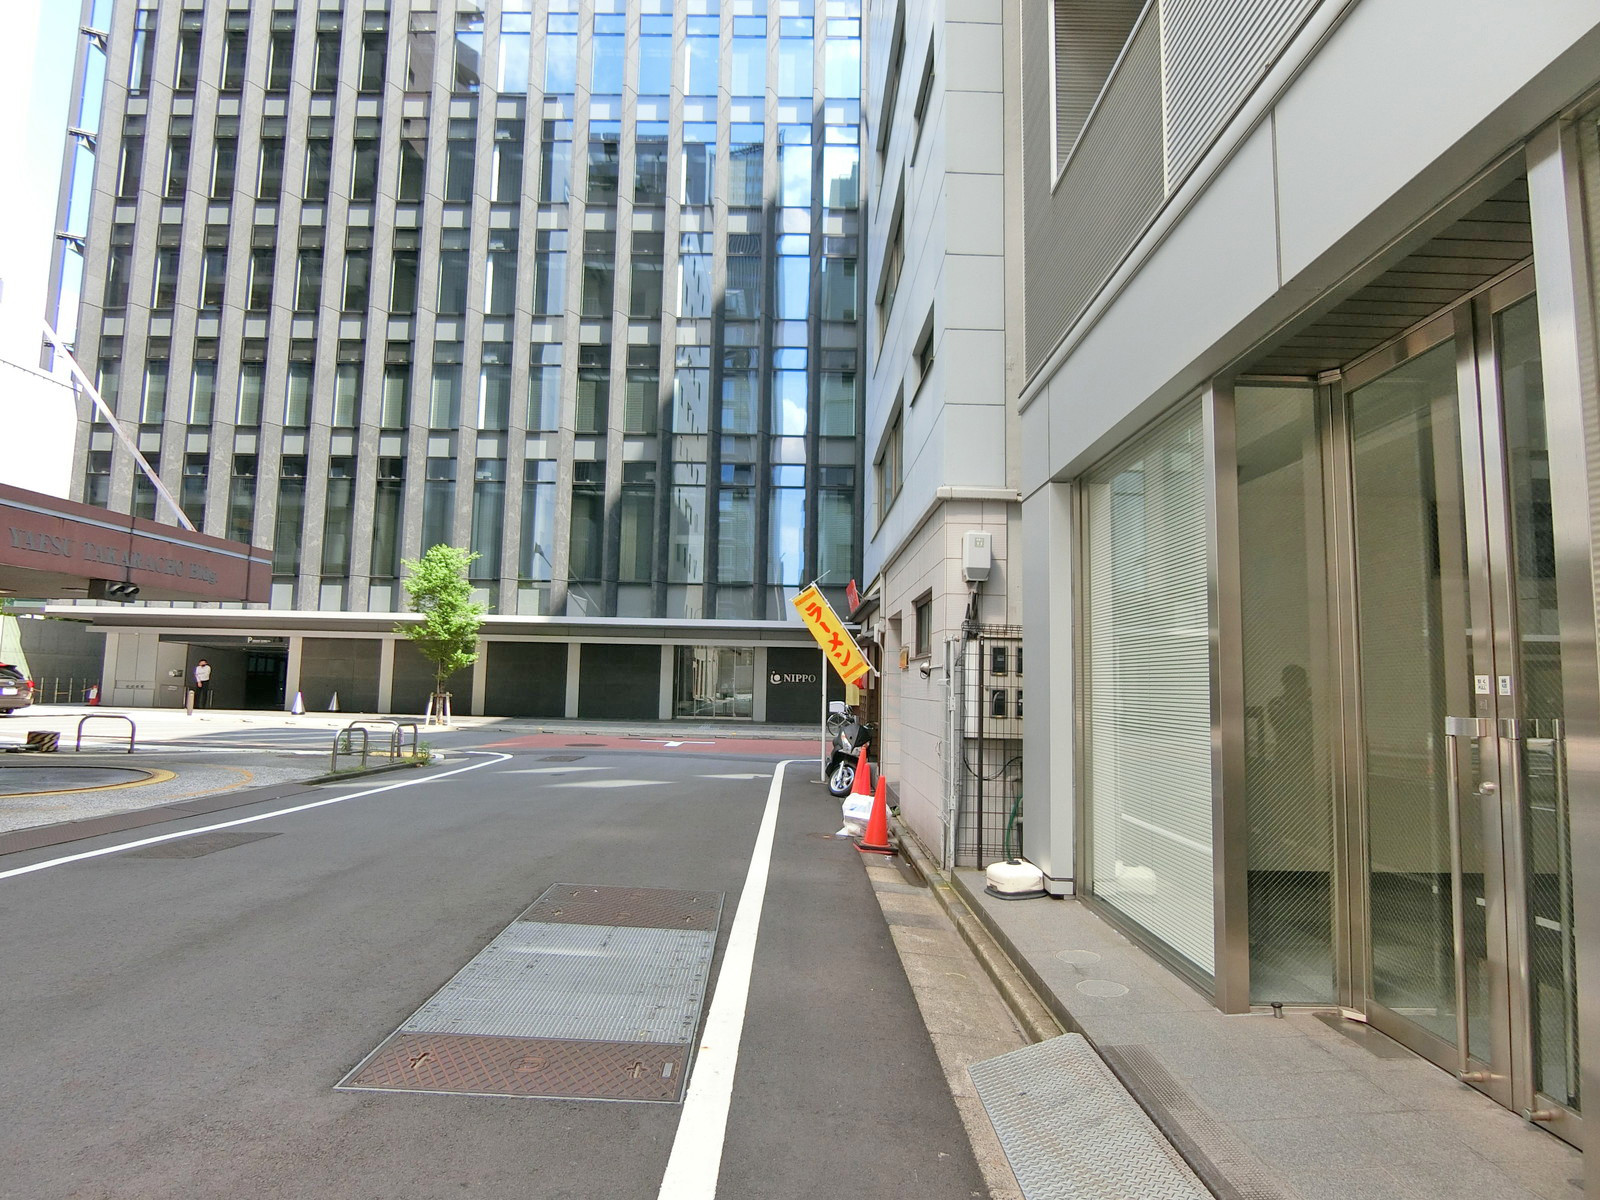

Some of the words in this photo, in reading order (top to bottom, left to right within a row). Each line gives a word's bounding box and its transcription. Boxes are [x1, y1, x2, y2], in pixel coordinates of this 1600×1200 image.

[9, 527, 74, 558] YAESU
[805, 602, 851, 667] ラーメン
[783, 673, 816, 683] NIPPO
